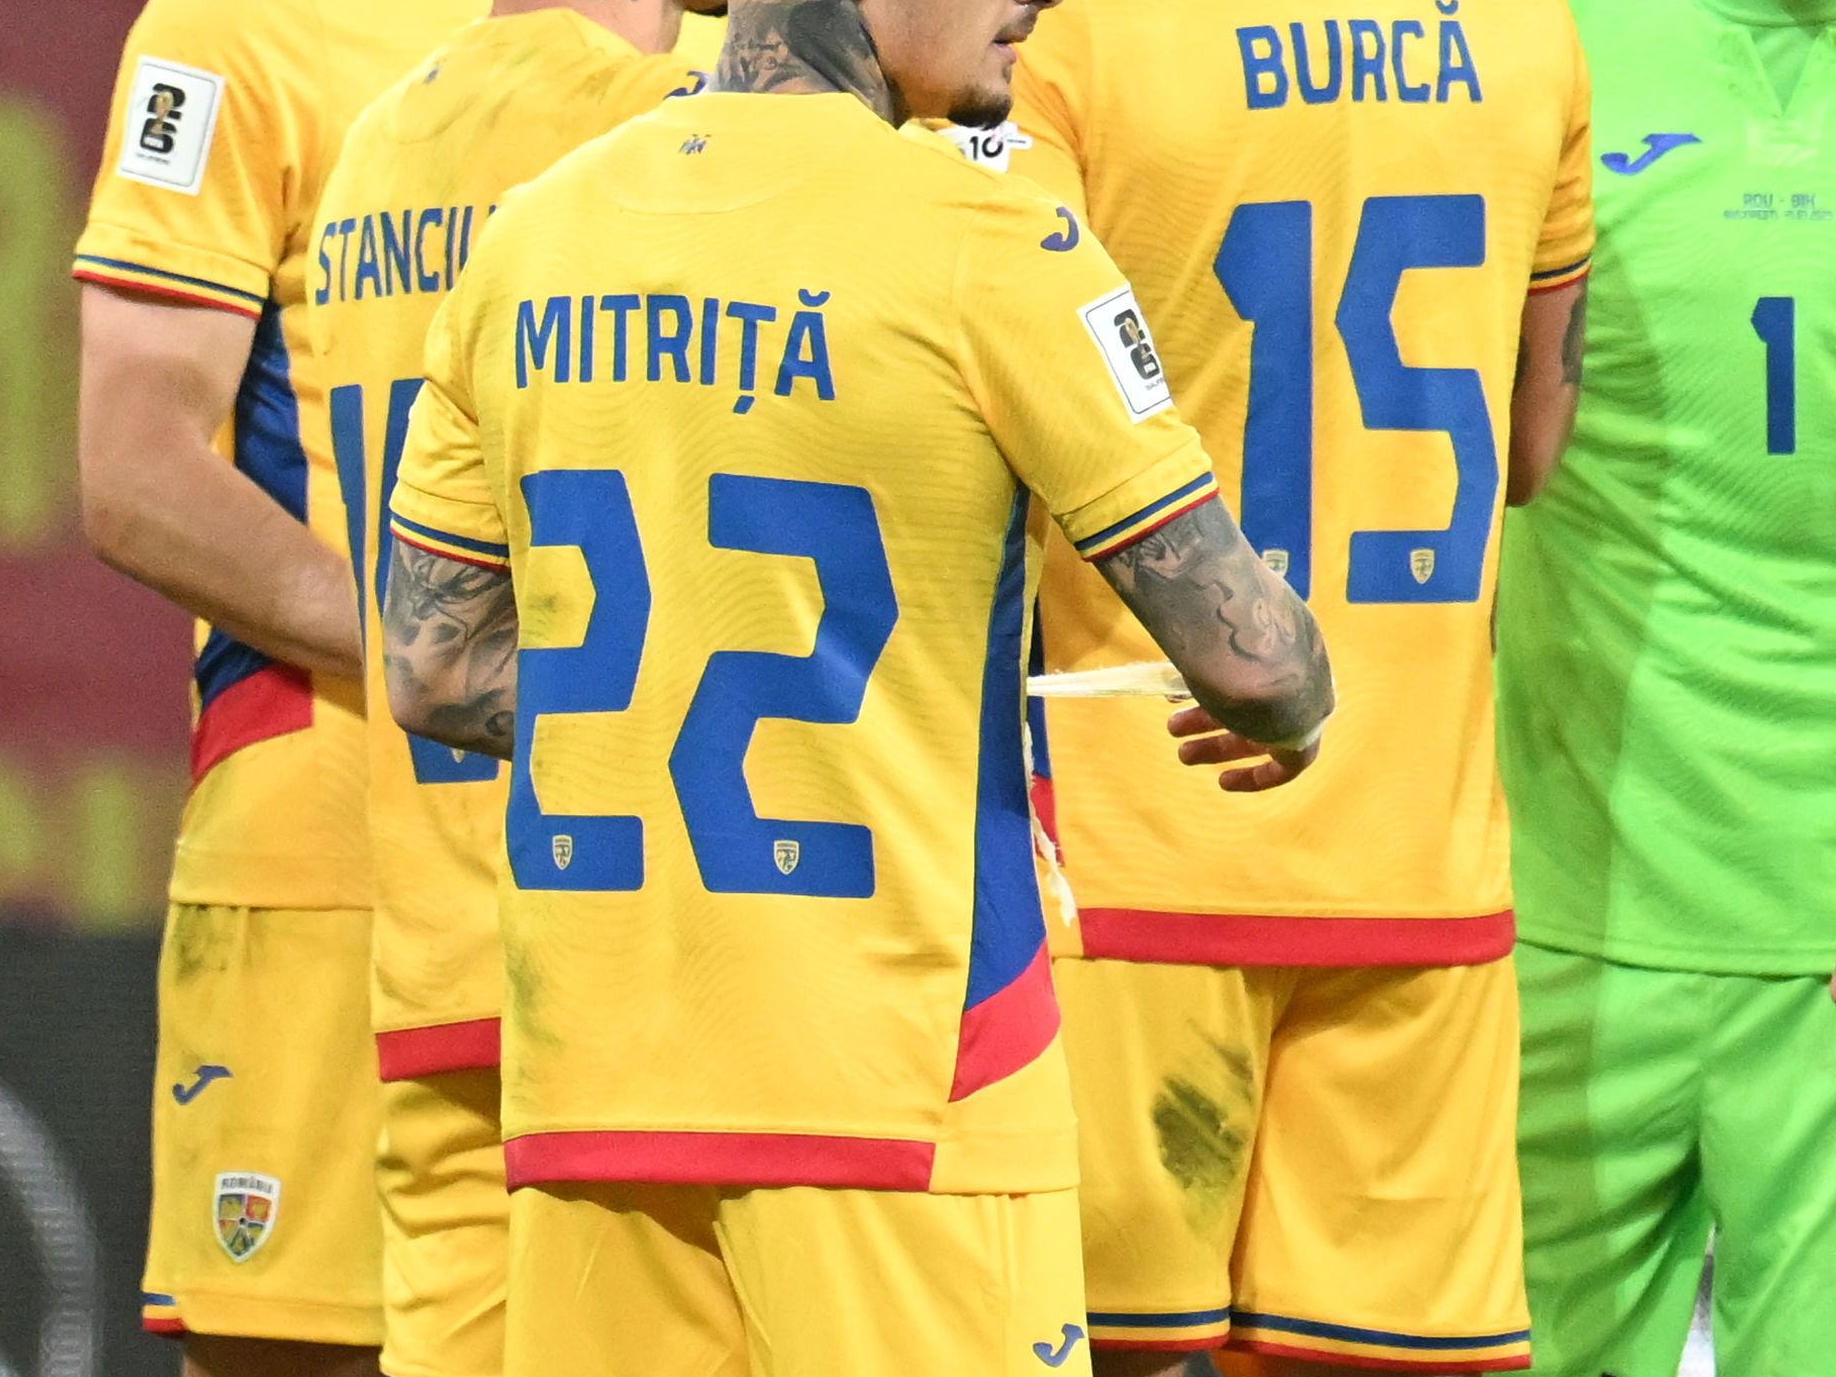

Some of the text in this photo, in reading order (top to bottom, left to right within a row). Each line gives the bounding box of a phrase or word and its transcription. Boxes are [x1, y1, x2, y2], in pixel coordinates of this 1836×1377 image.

[515, 288, 836, 414] MITRIȚĂ
[1212, 193, 1501, 604] 15
[1750, 295, 1796, 455] 1
[505, 469, 901, 900] 22
